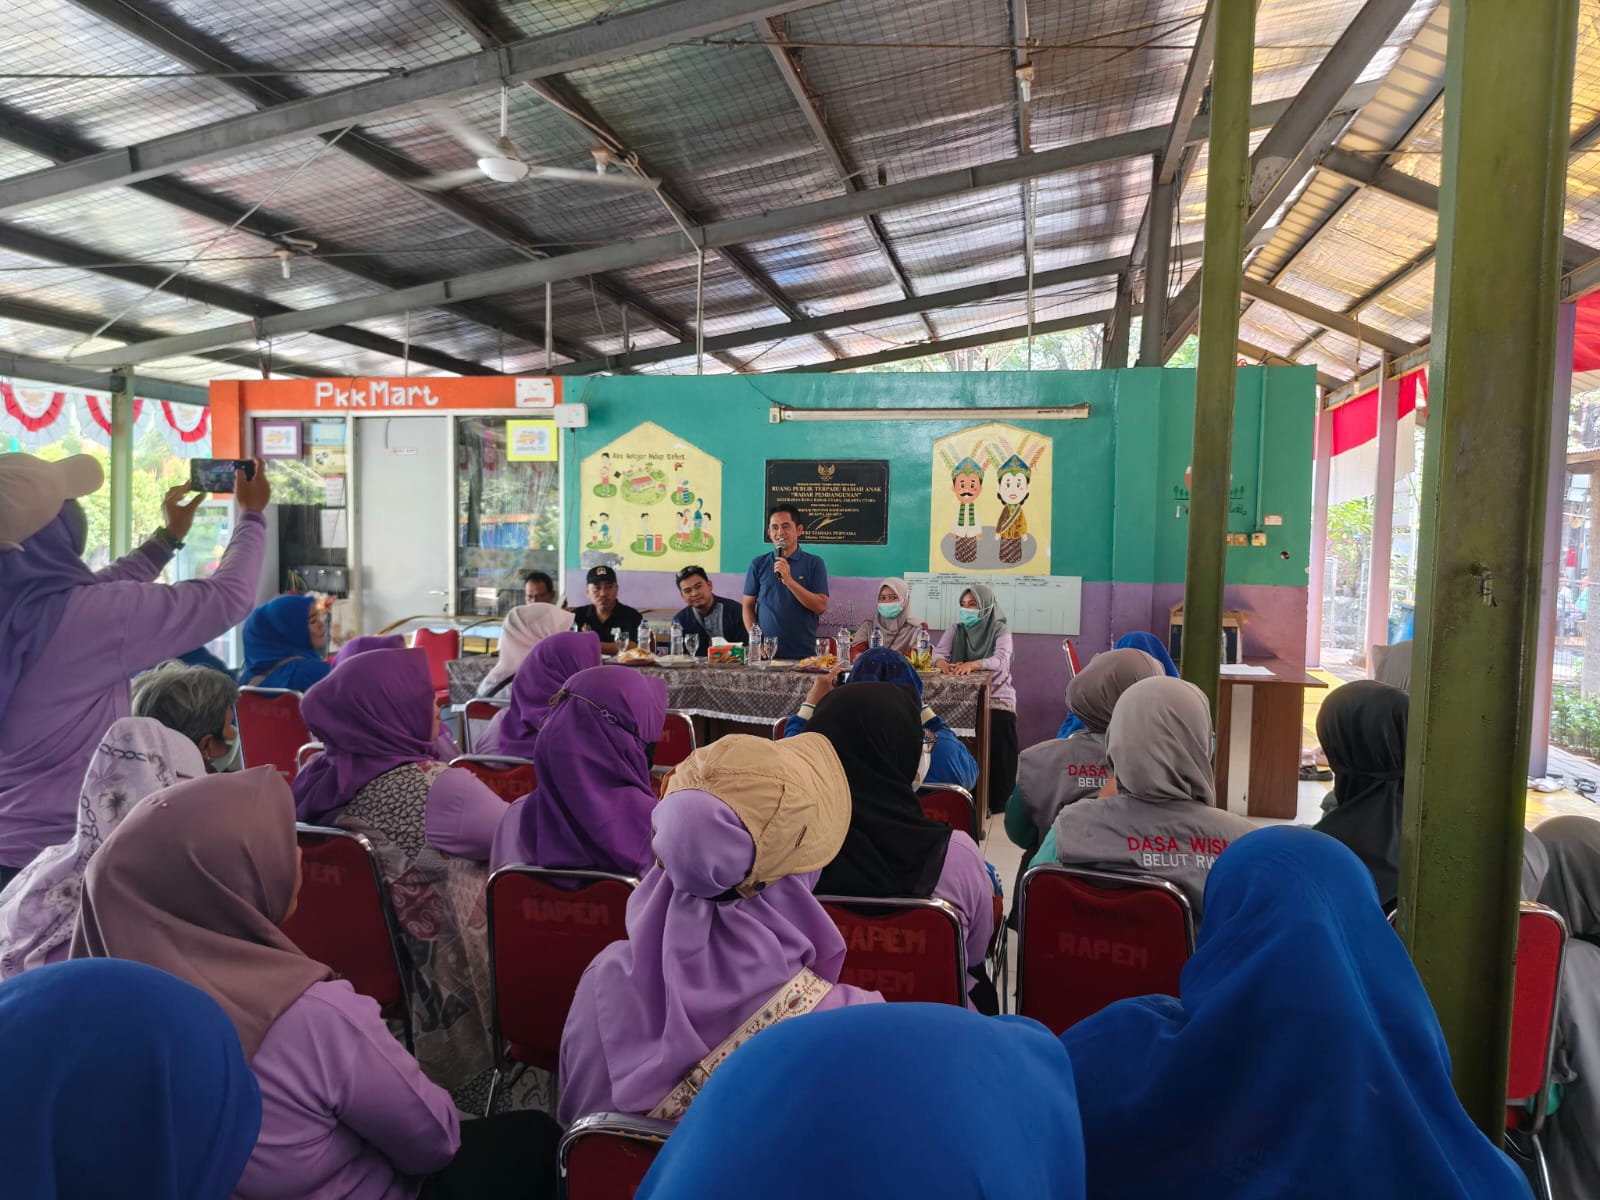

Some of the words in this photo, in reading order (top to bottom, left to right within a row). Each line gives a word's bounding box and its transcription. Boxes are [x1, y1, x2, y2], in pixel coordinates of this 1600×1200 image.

[1068, 764, 1108, 777] DASA
[1127, 835, 1180, 852] DASA
[1143, 853, 1188, 867] BELUT
